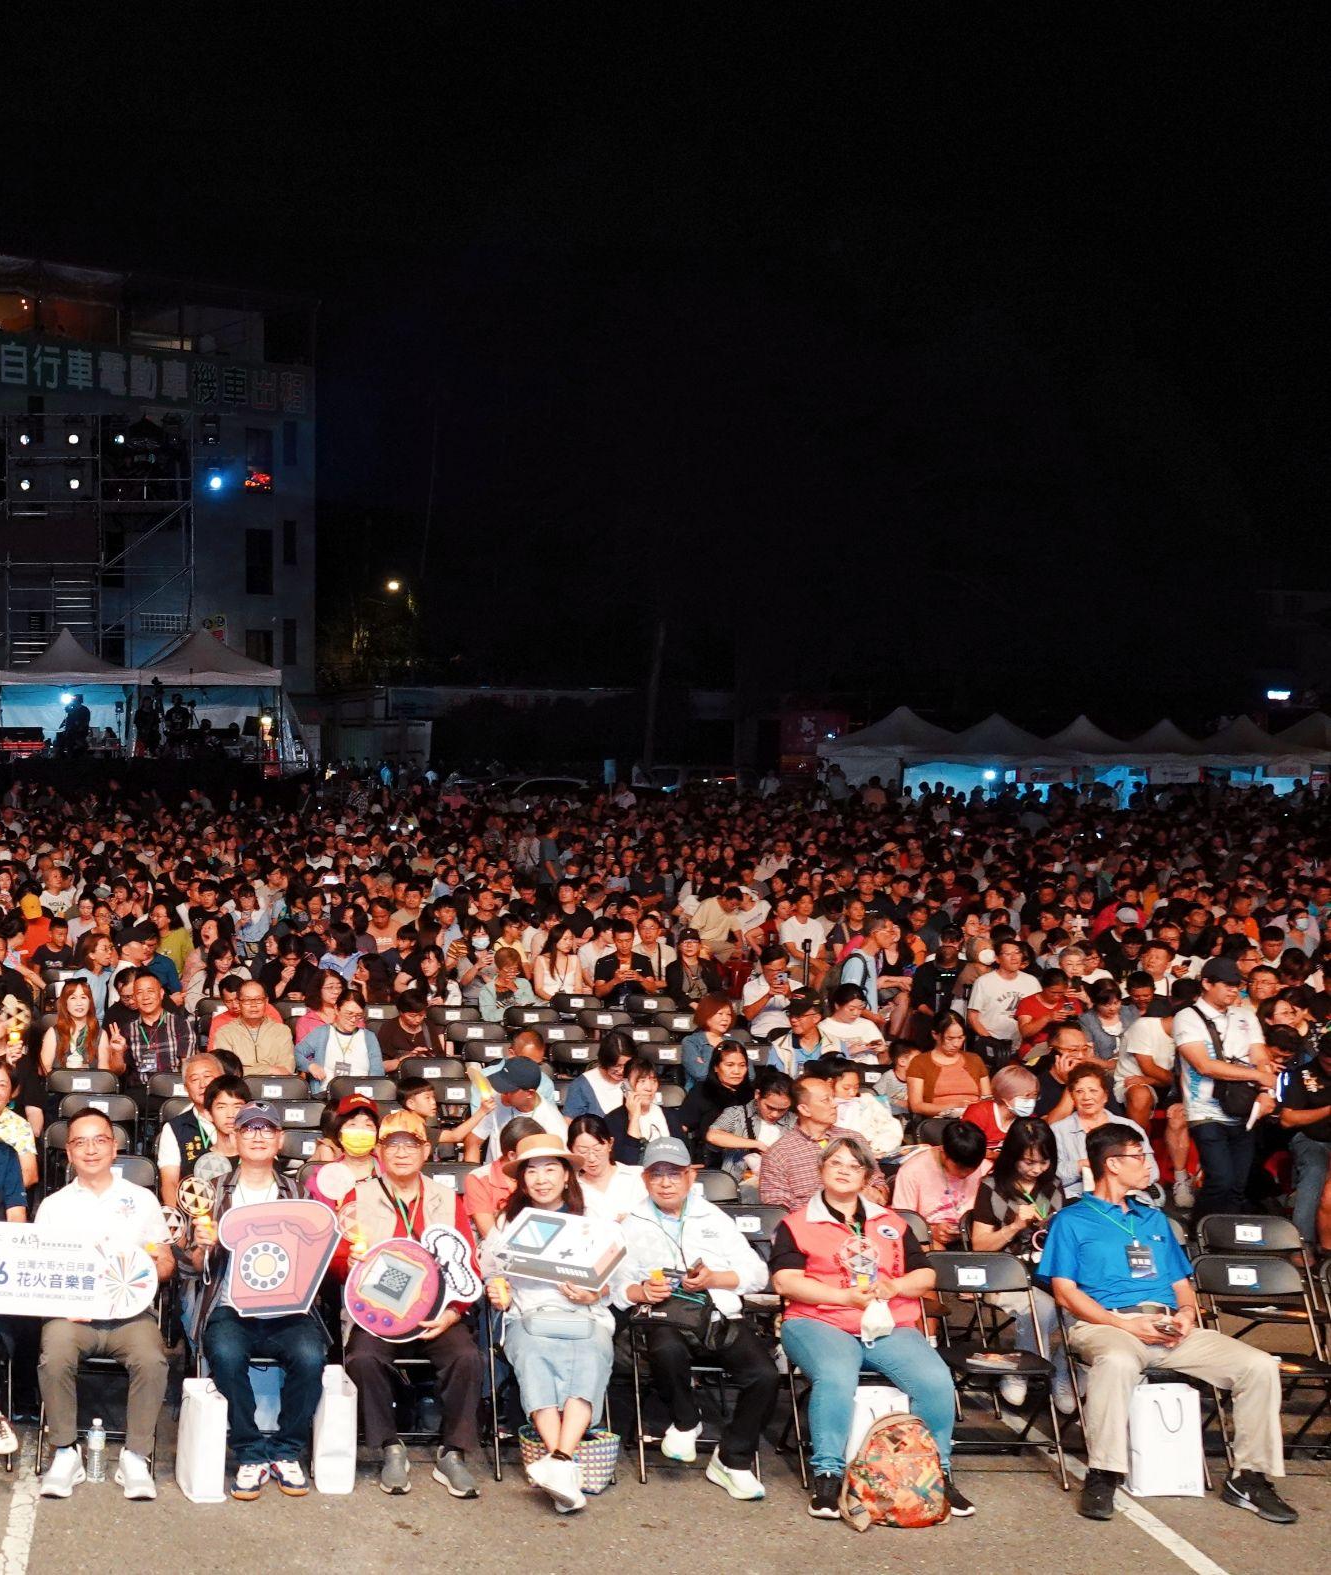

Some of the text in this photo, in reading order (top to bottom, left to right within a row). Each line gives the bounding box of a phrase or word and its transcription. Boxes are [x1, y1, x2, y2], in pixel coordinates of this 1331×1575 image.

[17, 1272, 96, 1291] 花火音樂會
